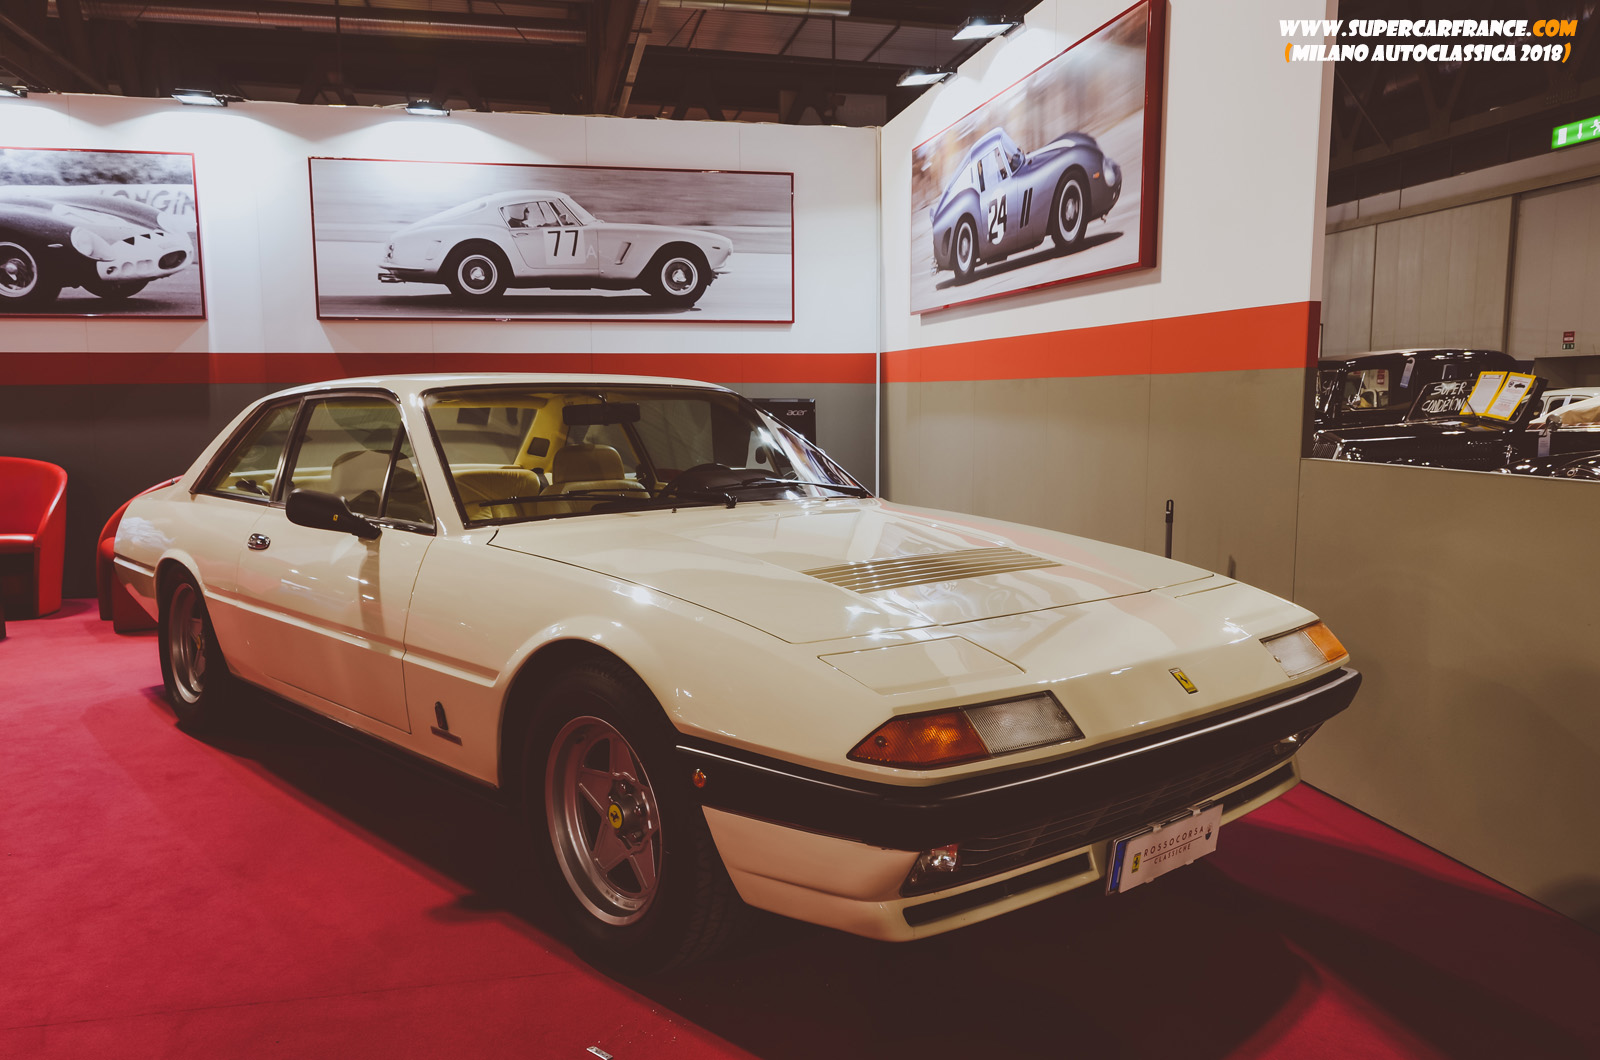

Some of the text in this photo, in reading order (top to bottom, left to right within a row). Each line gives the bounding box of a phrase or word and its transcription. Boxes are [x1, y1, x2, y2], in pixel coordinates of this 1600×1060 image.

[988, 194, 1007, 243] 24
[547, 229, 597, 259] 77 A
[1431, 381, 1467, 396] SUPER
[1143, 825, 1204, 858] ROSSOCORSA
[1153, 843, 1191, 865] CLASSICHE
